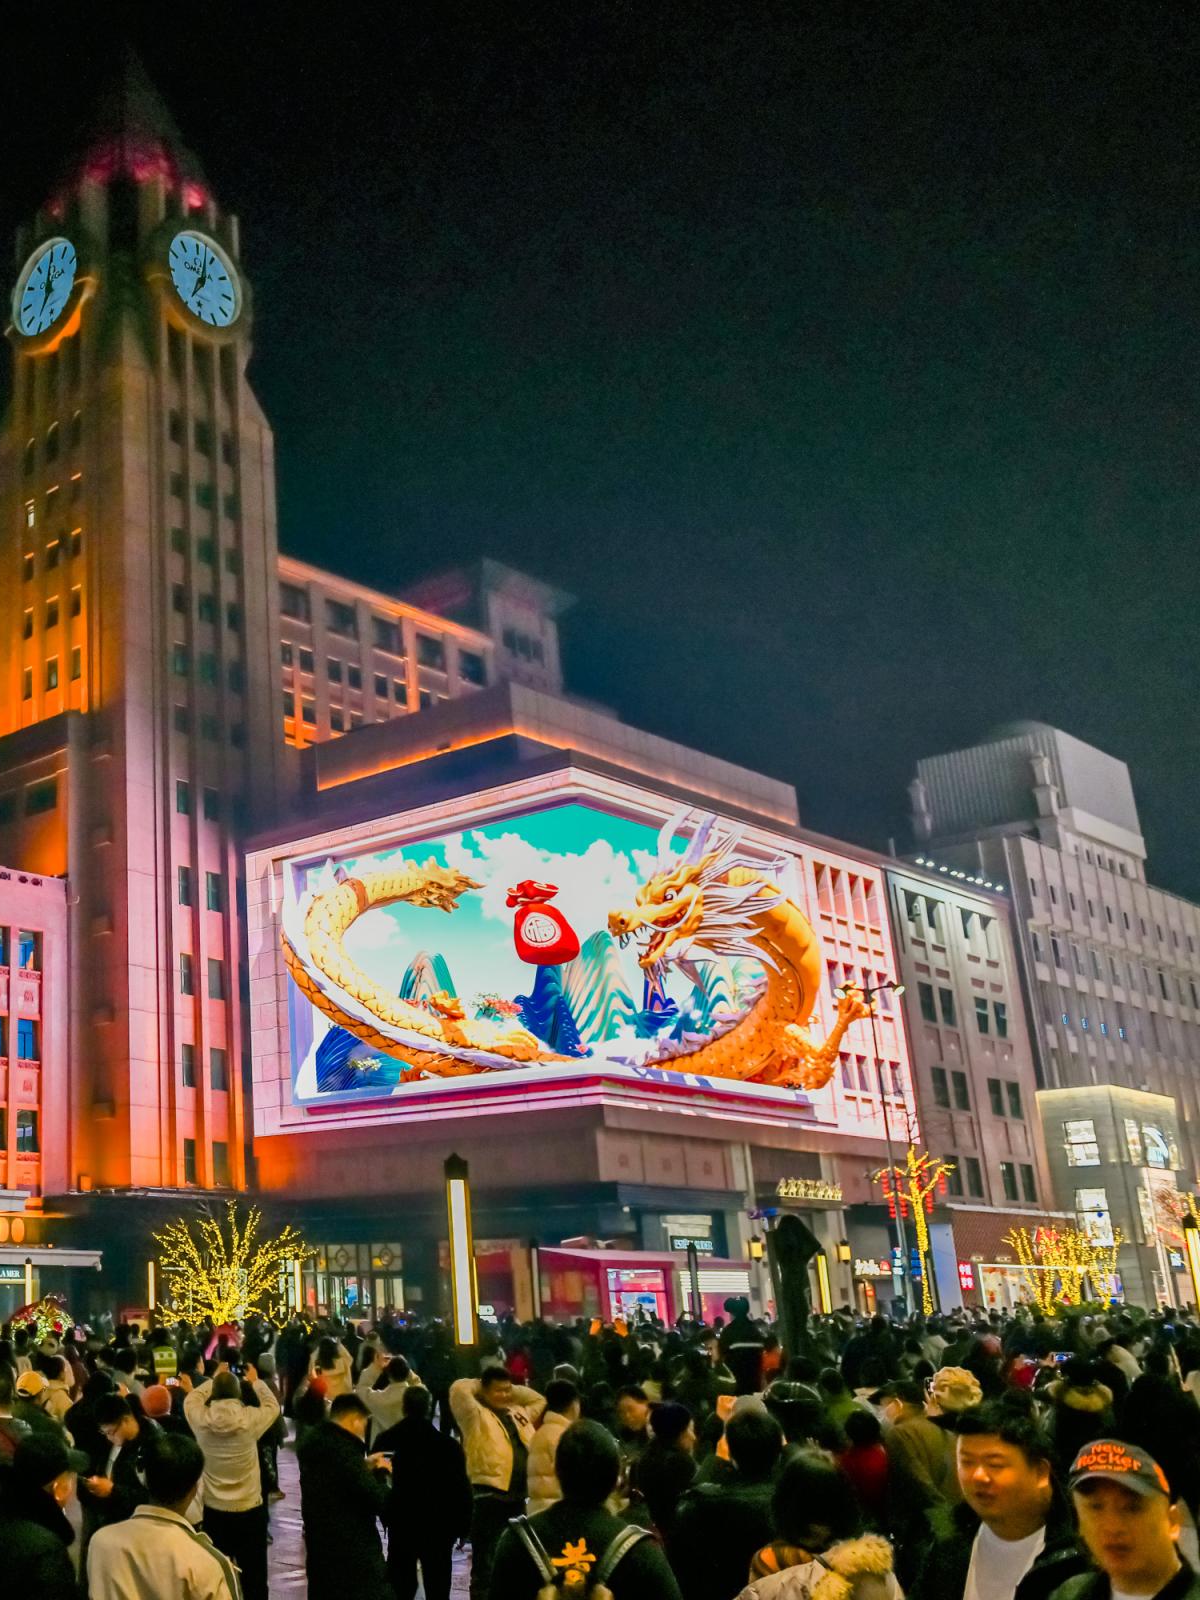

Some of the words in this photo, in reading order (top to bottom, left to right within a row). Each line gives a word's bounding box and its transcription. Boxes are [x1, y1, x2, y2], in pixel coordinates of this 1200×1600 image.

[40, 268, 65, 290] OEGA
[184, 261, 213, 282] OMEA
[6, 1270, 20, 1279] MER
